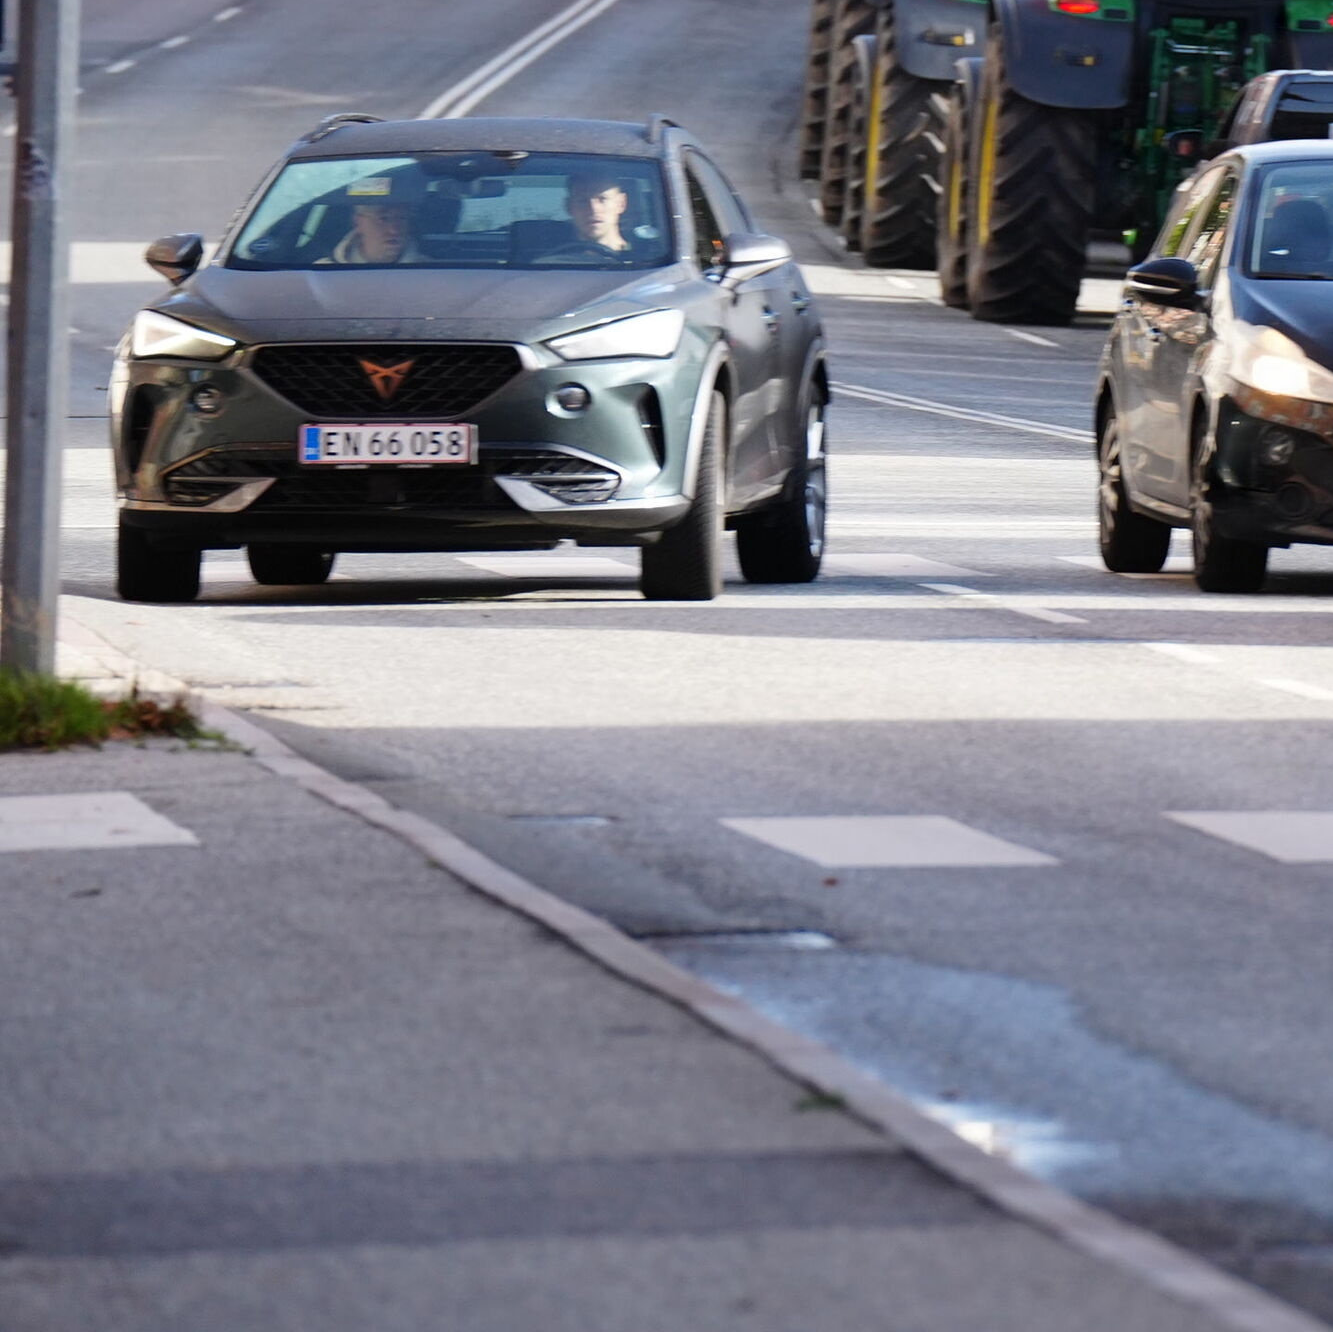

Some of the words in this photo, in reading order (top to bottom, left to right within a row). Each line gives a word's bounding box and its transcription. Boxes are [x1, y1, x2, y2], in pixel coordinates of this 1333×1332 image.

[323, 431, 362, 456] EN
[369, 431, 403, 456] 66
[410, 431, 463, 456] 058
